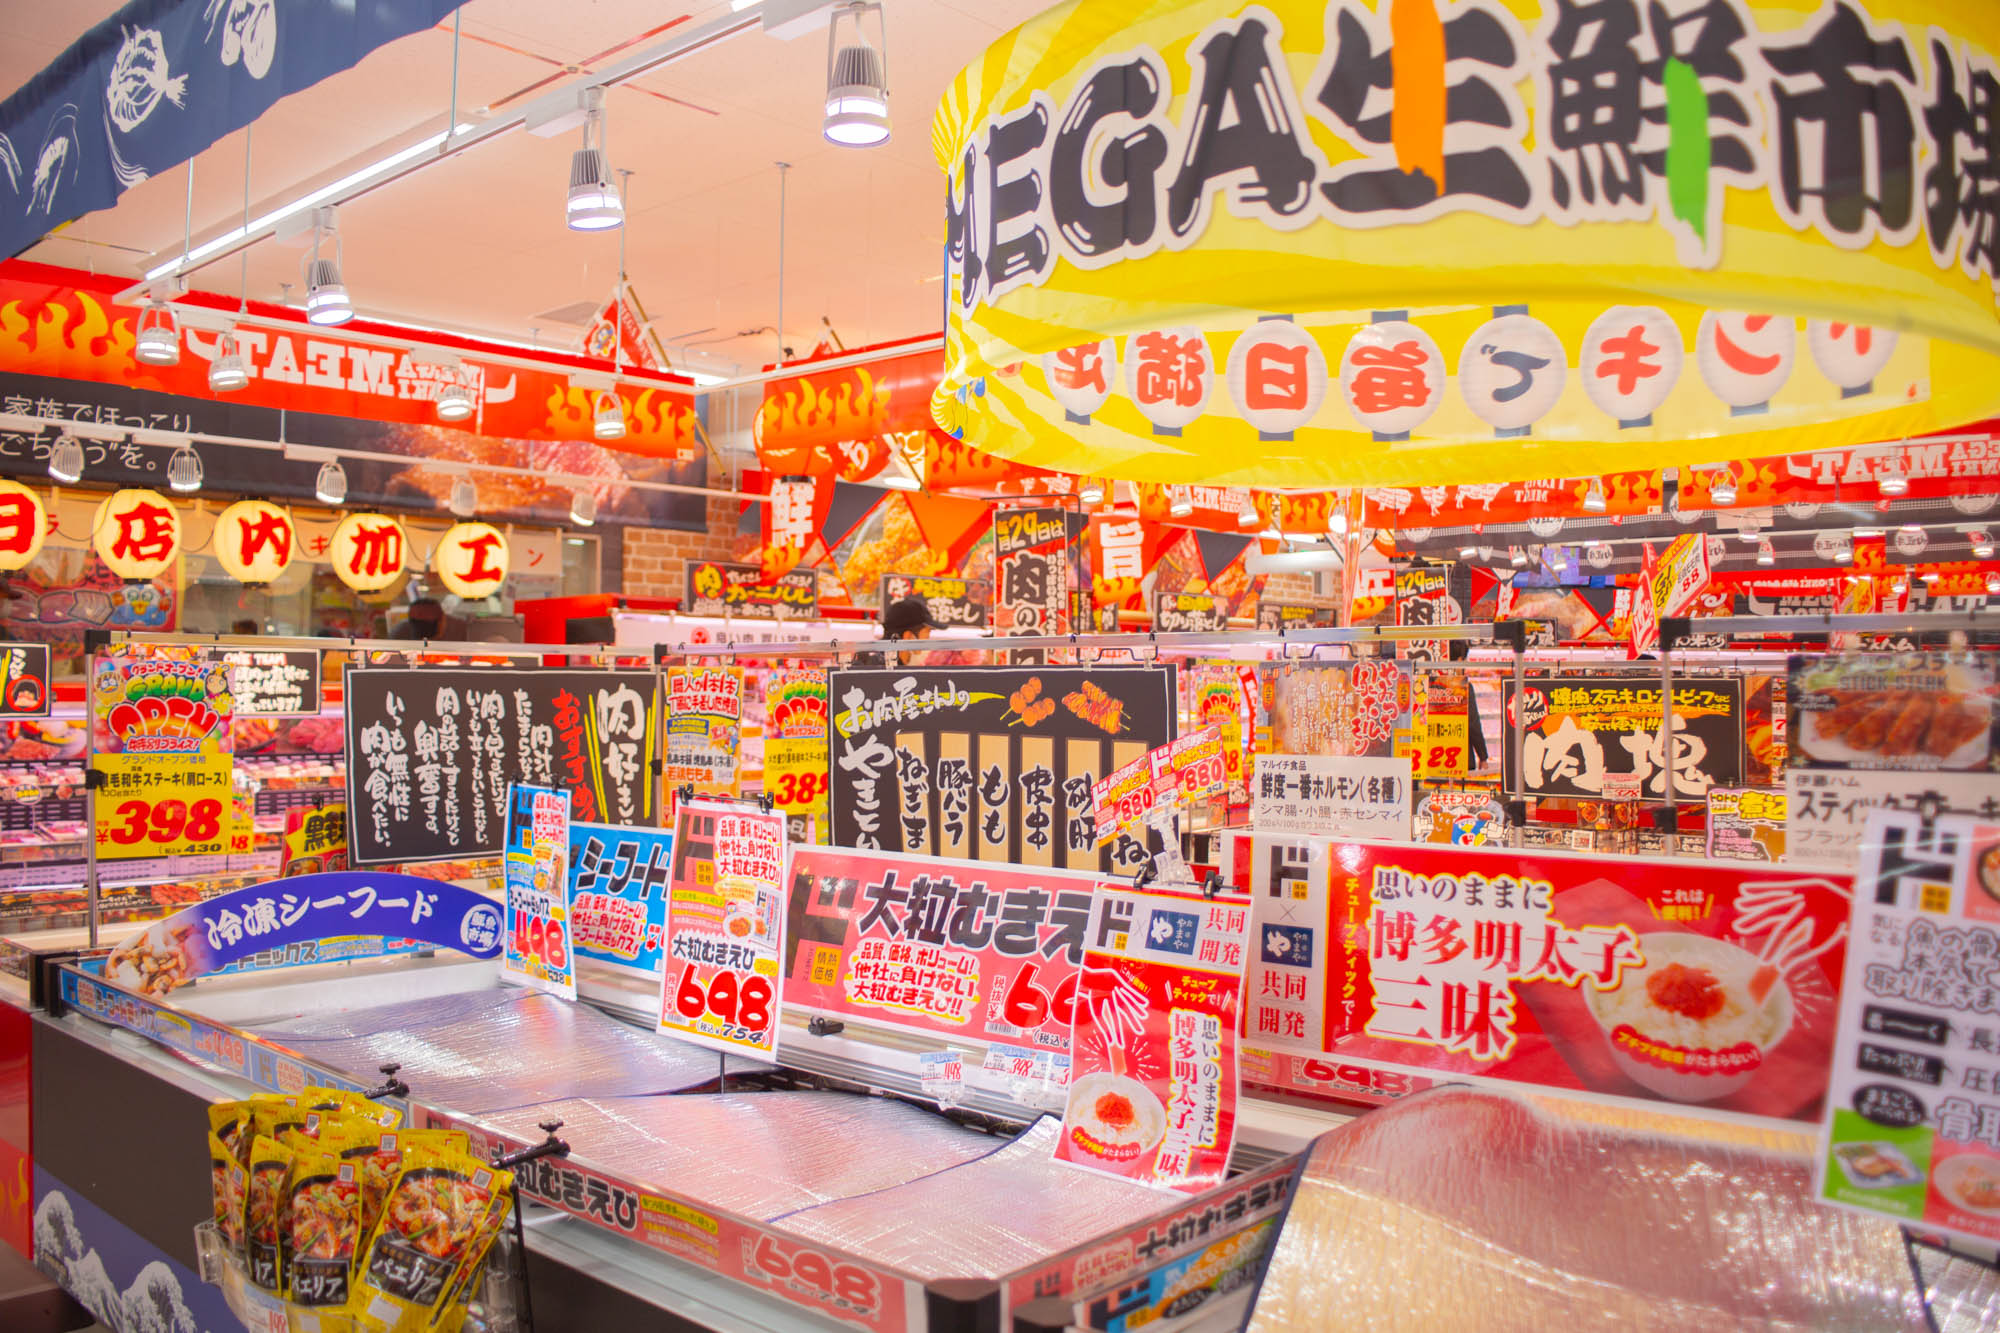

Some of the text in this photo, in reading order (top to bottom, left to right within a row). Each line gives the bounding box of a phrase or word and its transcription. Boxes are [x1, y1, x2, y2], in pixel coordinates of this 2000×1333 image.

[4, 395, 191, 433] 家族でほっこり
[840, 676, 971, 733] お肉屋さんの
[597, 683, 646, 825] 肉好き
[1427, 746, 1462, 769] 28
[1184, 757, 1223, 793] 880
[1260, 772, 1403, 804] 鮮度一番ホルモン(各種)
[896, 749, 930, 849] ねぎま
[938, 758, 974, 846] 豚バラ
[978, 767, 1009, 844] もも
[1020, 767, 1056, 850] 皮串
[1121, 786, 1153, 822] 880
[110, 798, 224, 845] 398
[304, 811, 346, 852] 黒毛
[1374, 869, 1551, 910] 思いのままに
[206, 885, 439, 950] 冷凍シーフード
[859, 871, 1088, 966] 大粒むきえ
[1205, 906, 1246, 934] 共同
[571, 928, 640, 956] ーフードミックス!
[672, 934, 755, 971] 大粒むきえび
[1198, 938, 1242, 967] 開発
[1340, 877, 1361, 1033] チューブティックで!
[1372, 908, 1643, 990] 博多明太子
[676, 962, 774, 1033] 698
[853, 960, 977, 999] 他社に負けない
[853, 981, 963, 1016] 大粒むきえび!!
[1181, 975, 1219, 991] チューブ
[1258, 970, 1307, 1001] 共同
[1258, 1006, 1306, 1039] 開発
[1199, 1017, 1220, 1144] 思いのままに
[372, 1257, 441, 1296] パエリア
